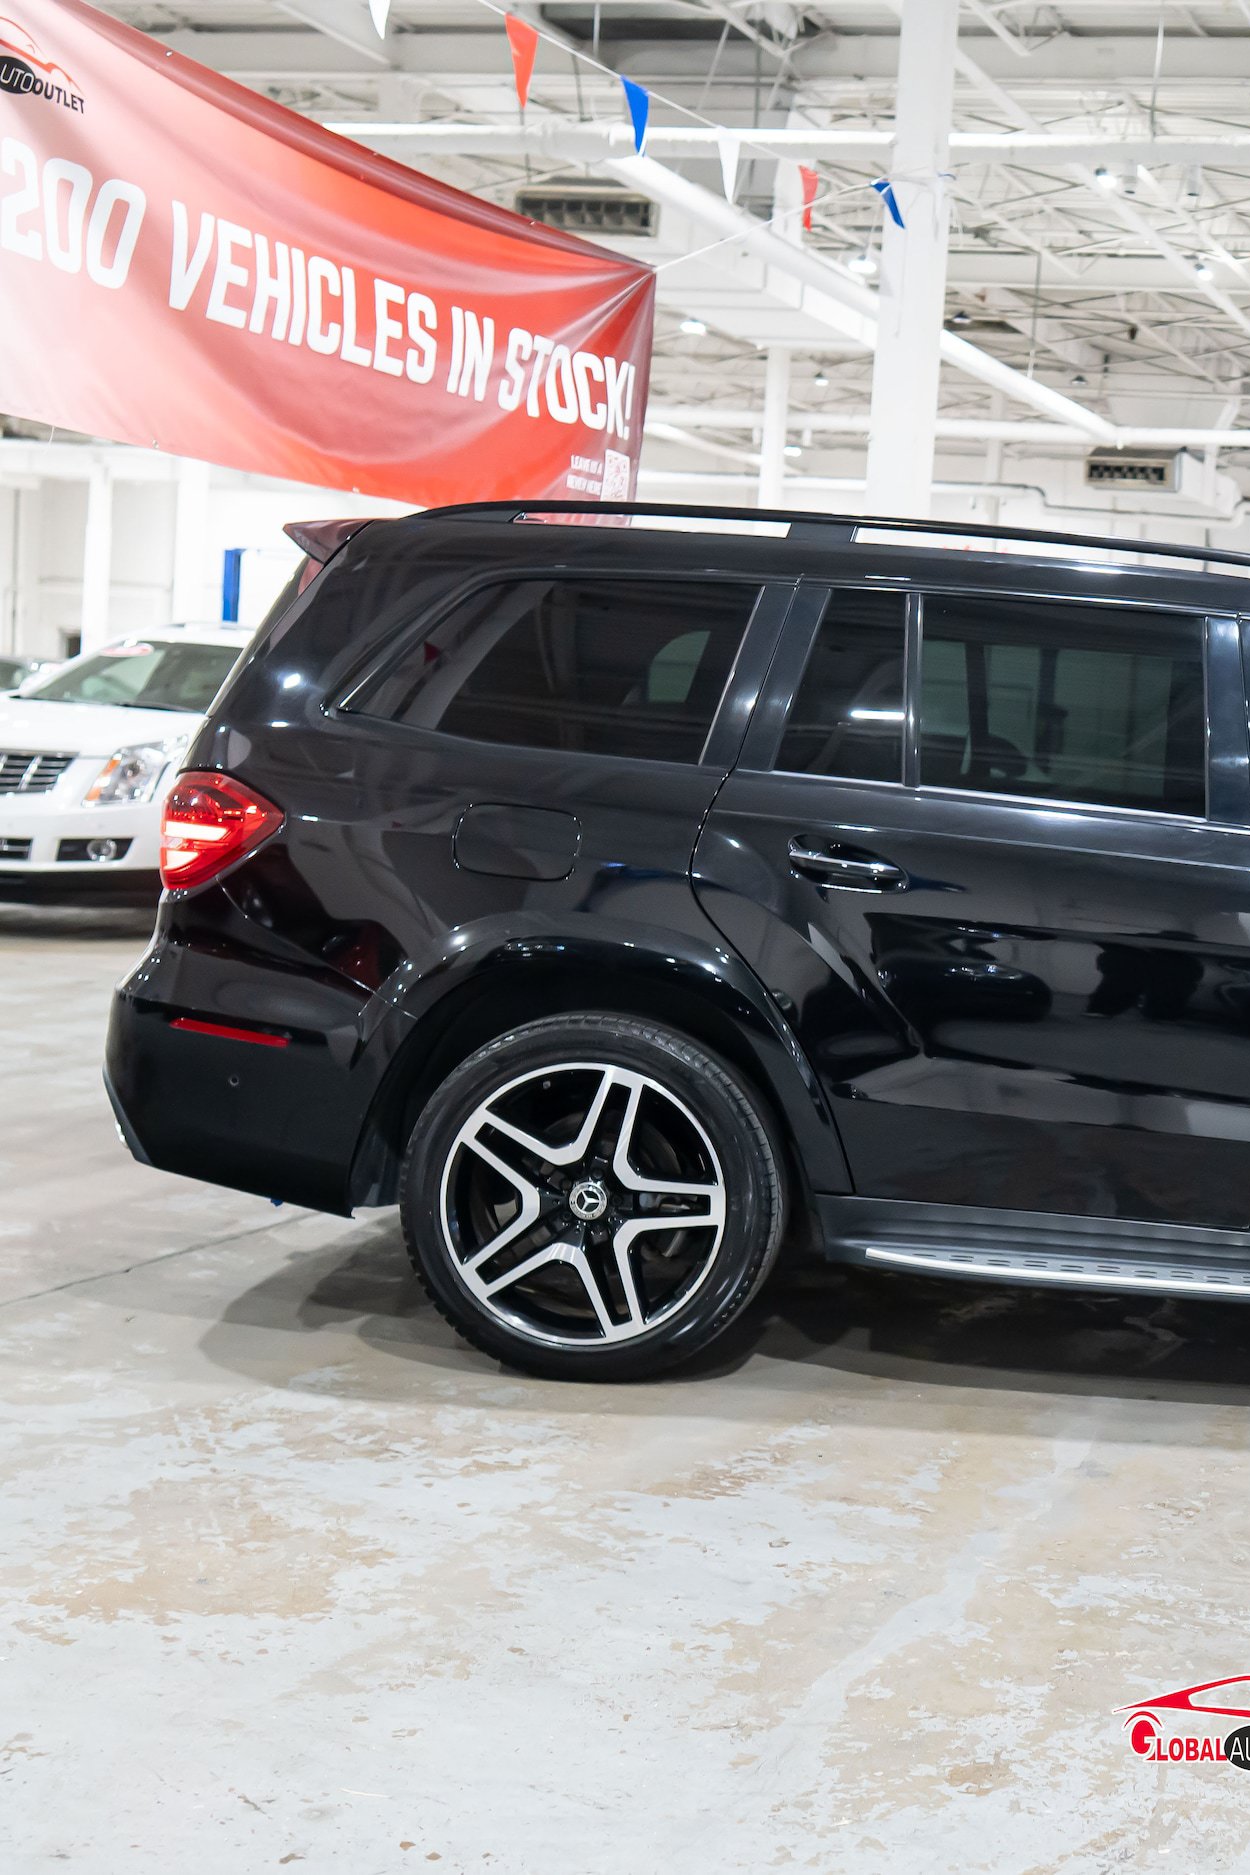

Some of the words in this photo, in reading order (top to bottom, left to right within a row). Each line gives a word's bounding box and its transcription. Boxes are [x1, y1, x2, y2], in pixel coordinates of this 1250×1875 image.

[0, 62, 35, 92] UTO
[0, 136, 147, 290] 200
[169, 200, 437, 384] VEHICLES
[447, 306, 494, 401] IN
[498, 327, 636, 440] STOCK!
